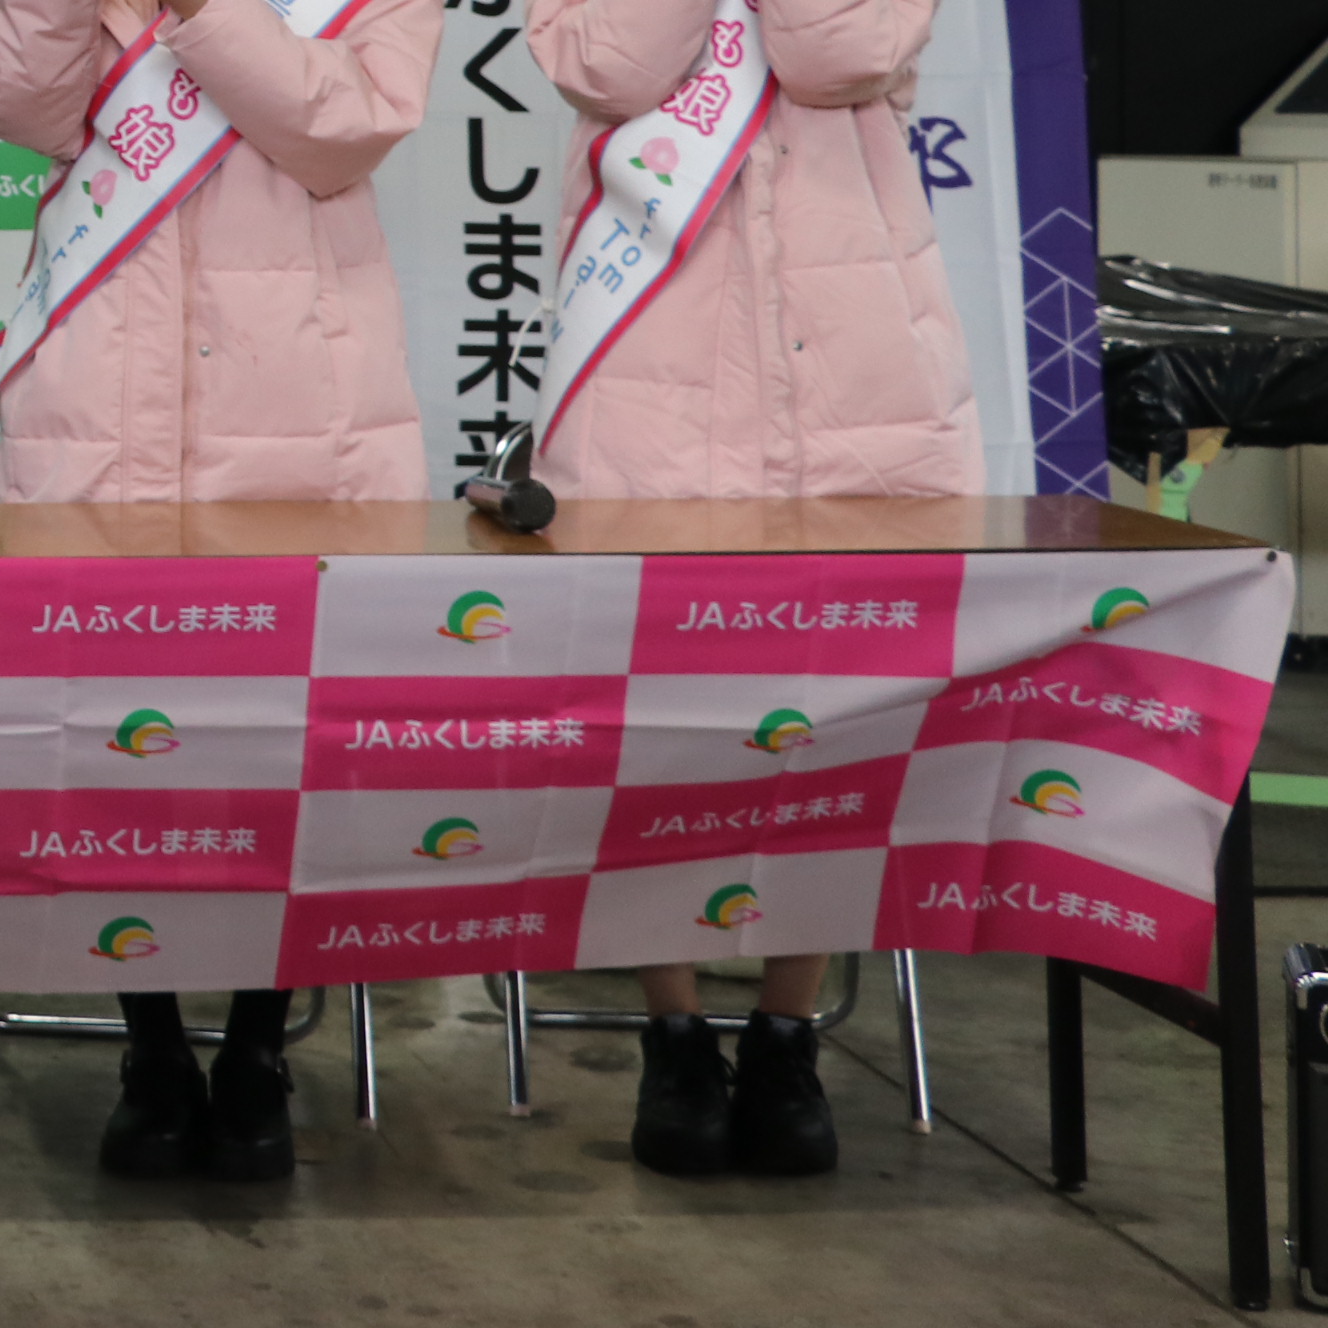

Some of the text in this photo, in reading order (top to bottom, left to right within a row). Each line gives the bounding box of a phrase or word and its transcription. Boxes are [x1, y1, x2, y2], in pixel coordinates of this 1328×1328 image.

[33, 604, 277, 634] JAふくしま未来
[677, 601, 919, 632] JAふくしま未来
[961, 676, 1203, 736] JAふくしま未来
[347, 718, 584, 750] JAふくしま未来
[641, 793, 866, 839] JAふくしま未来
[20, 828, 256, 859] JAふくしま未来
[917, 882, 1159, 942] JAふくしま未来
[319, 914, 546, 951] JAふくしま未来
